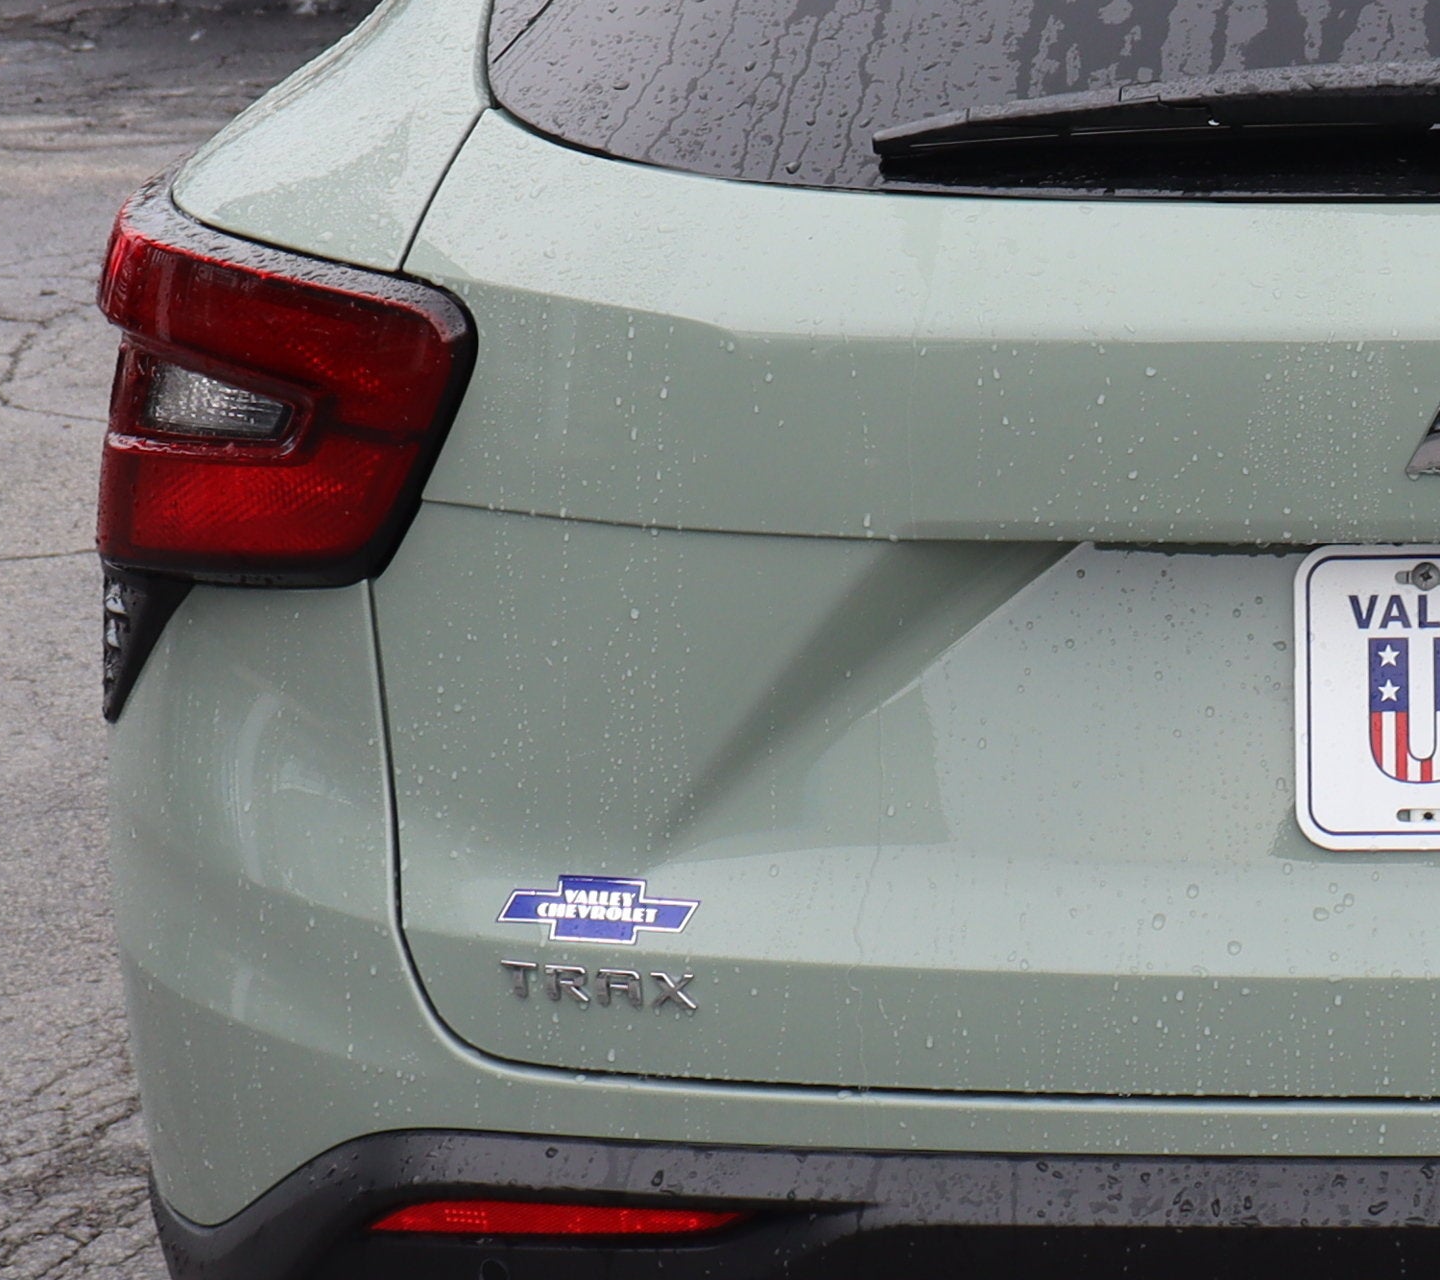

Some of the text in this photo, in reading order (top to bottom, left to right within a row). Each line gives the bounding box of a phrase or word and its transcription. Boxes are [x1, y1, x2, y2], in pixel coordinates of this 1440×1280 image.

[564, 889, 636, 907] VALLEY
[536, 902, 658, 923] CHEVROLET
[500, 959, 698, 1011] TRAX
